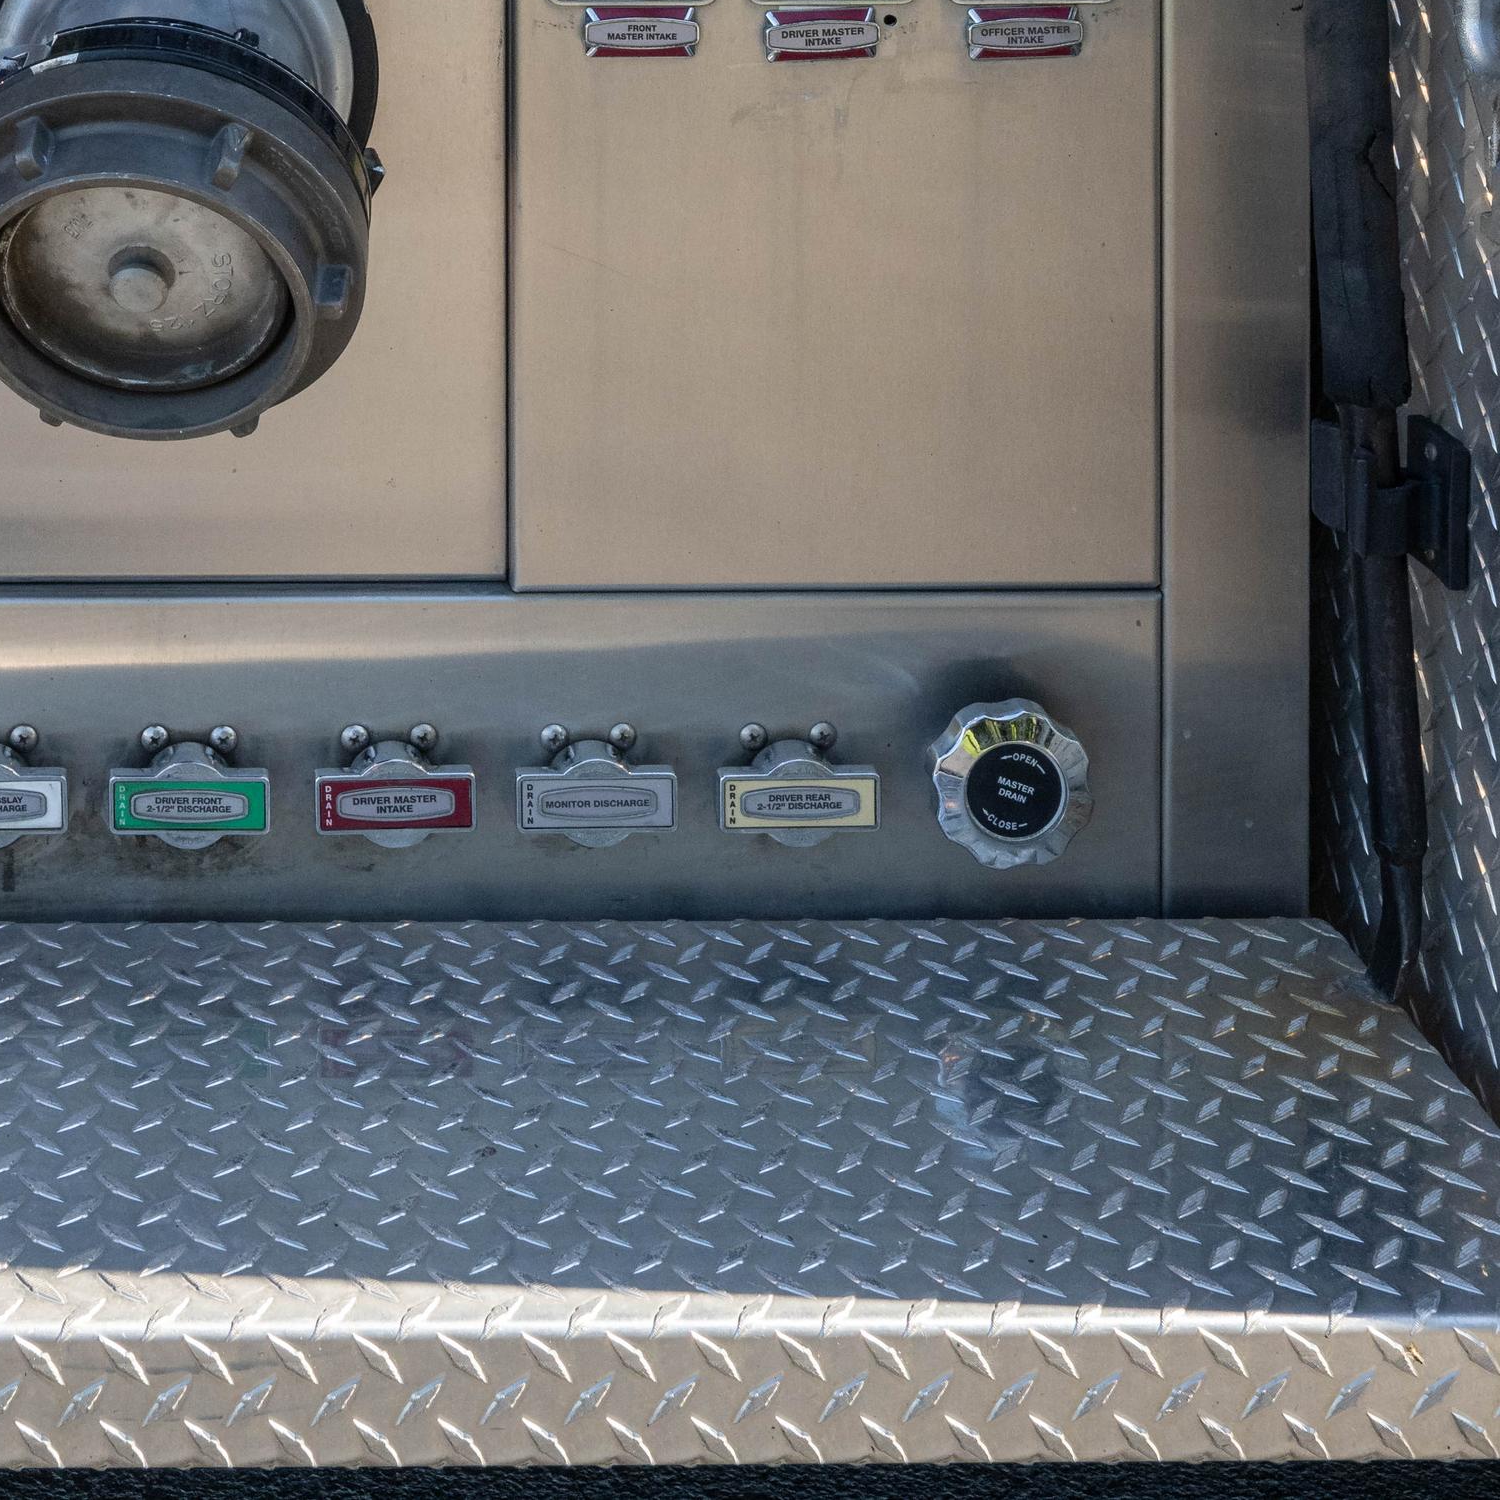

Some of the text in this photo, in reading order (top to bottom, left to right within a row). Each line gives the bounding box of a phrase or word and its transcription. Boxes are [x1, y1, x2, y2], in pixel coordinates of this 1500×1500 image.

[628, 24, 657, 32] FRONT
[1011, 752, 1039, 766] OPEN
[997, 775, 1034, 796] MASTER
[998, 787, 1026, 805] DRAIN
[986, 813, 1018, 831] CLOSE
